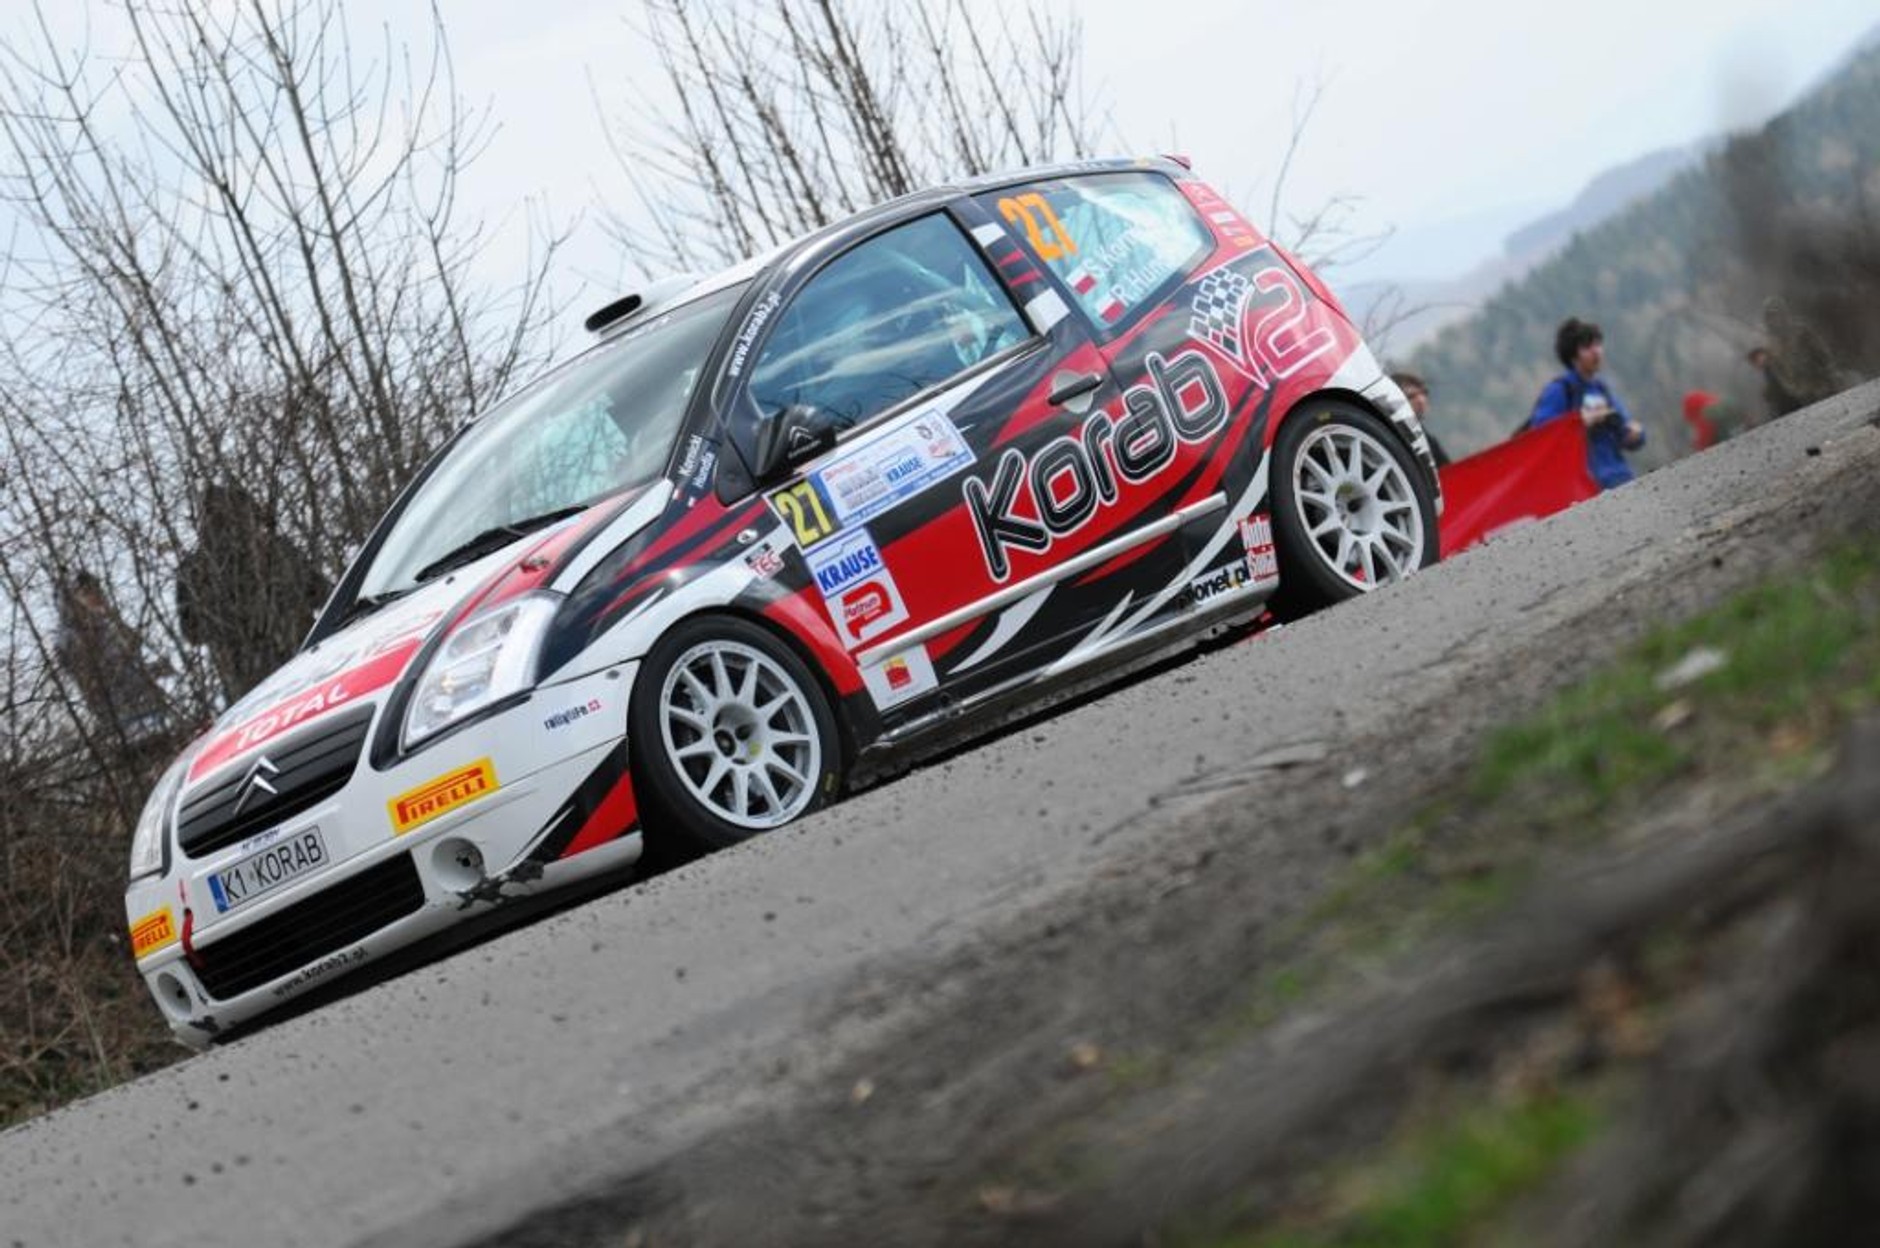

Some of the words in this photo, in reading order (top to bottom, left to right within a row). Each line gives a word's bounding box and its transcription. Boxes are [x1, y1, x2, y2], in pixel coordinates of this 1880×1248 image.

[997, 192, 1078, 263] 27
[962, 349, 1229, 584] Korab
[1252, 266, 1338, 379] 2
[777, 481, 833, 547] 27
[817, 545, 879, 591] KRAUSE
[236, 683, 351, 750] TOTAL
[396, 766, 487, 825] PIRELLI
[221, 867, 248, 902] K1
[252, 834, 323, 888] KORAB
